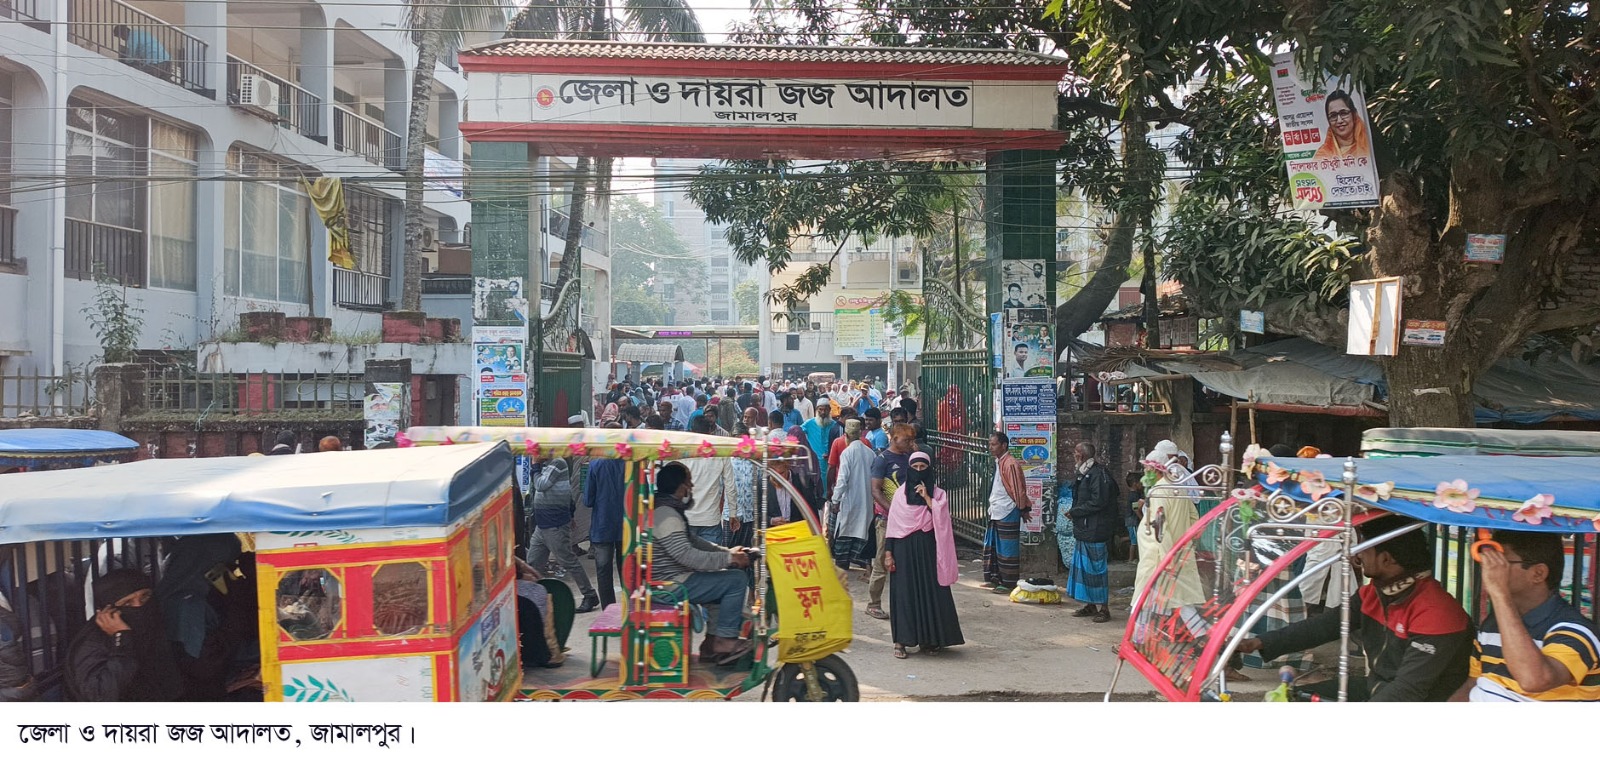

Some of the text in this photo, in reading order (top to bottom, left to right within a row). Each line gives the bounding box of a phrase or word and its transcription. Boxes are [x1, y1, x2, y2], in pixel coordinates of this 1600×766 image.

[560, 77, 970, 110] জেলা ও দায়রা জজ আদালত
[714, 111, 798, 123] জামালপুর
[1290, 155, 1368, 172] নিলোফার চৌধুরী মনি কে
[1296, 179, 1317, 187] সংসদ
[1336, 174, 1362, 185] হিসেবে
[1296, 187, 1323, 202] সদস্য
[1331, 186, 1355, 196] দেখতে
[793, 586, 824, 620] স্কুল
